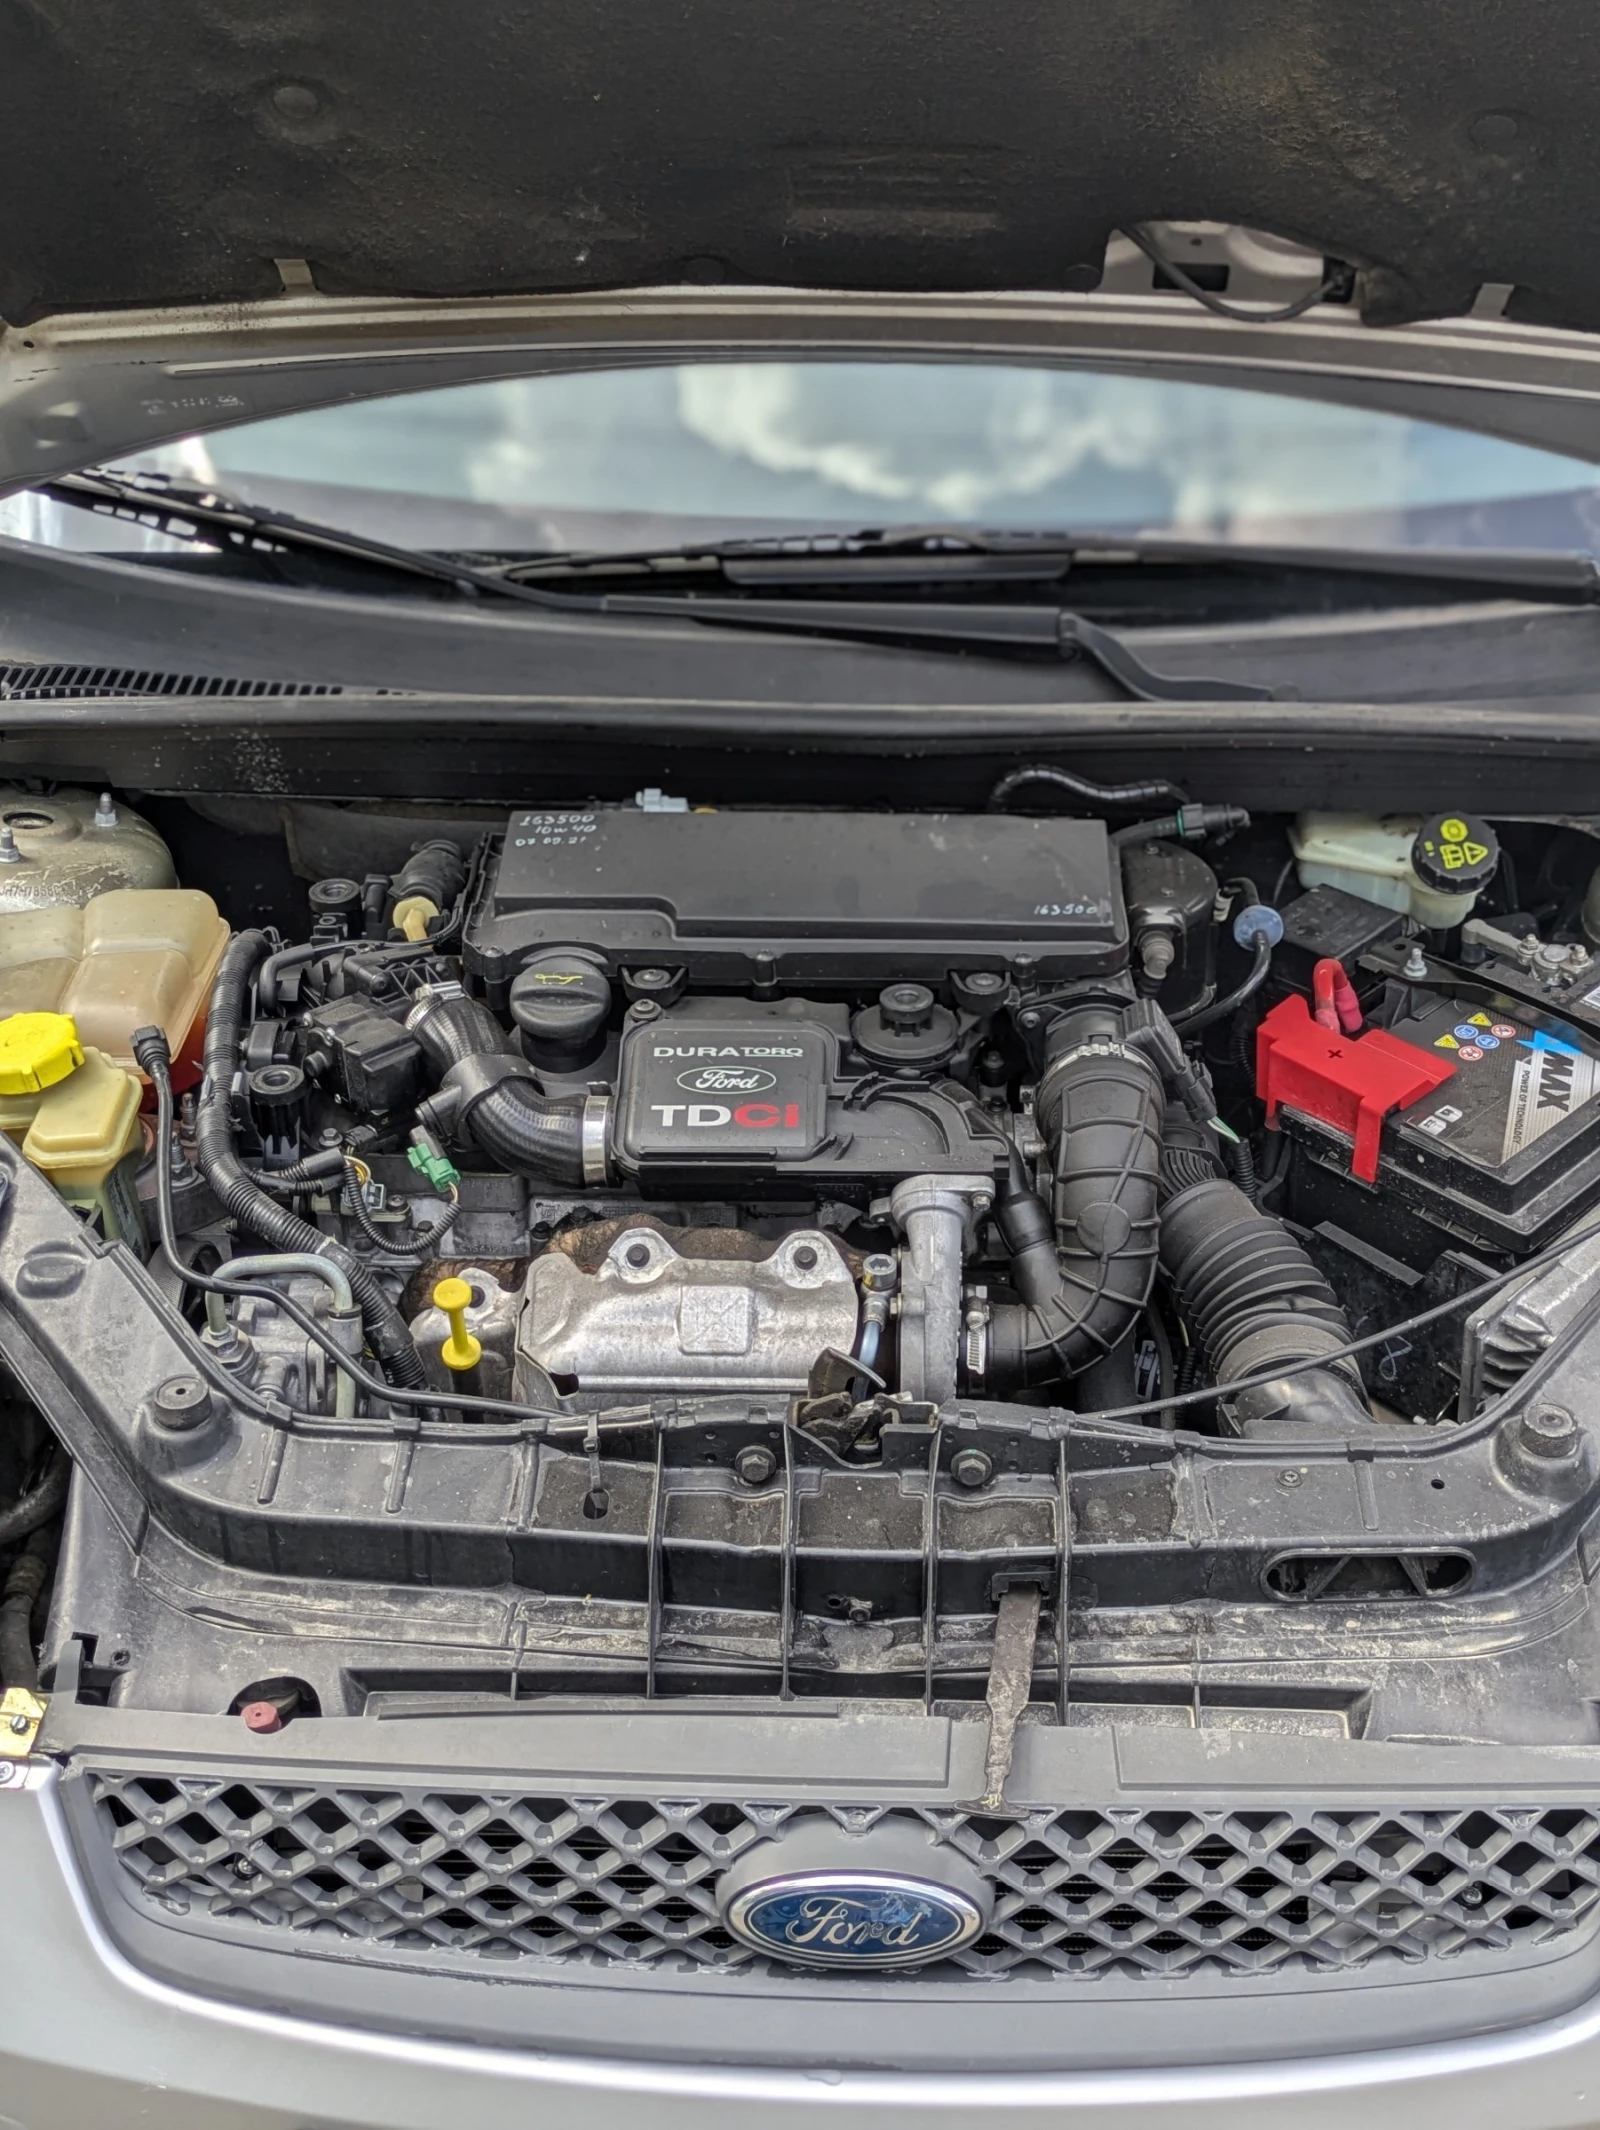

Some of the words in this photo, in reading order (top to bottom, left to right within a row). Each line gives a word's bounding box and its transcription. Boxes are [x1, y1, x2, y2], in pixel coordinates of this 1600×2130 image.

[519, 814, 595, 826] 163500
[1033, 903, 1098, 915] 163500
[653, 1046, 803, 1058] DURATORQ
[695, 1068, 761, 1089] Ford
[1520, 1069, 1531, 1094] POWER
[1537, 1049, 1574, 1112] MAX
[1518, 1094, 1528, 1103] OF
[1512, 1103, 1526, 1145] TECHNOLOGY
[785, 1896, 924, 1946] Ford
